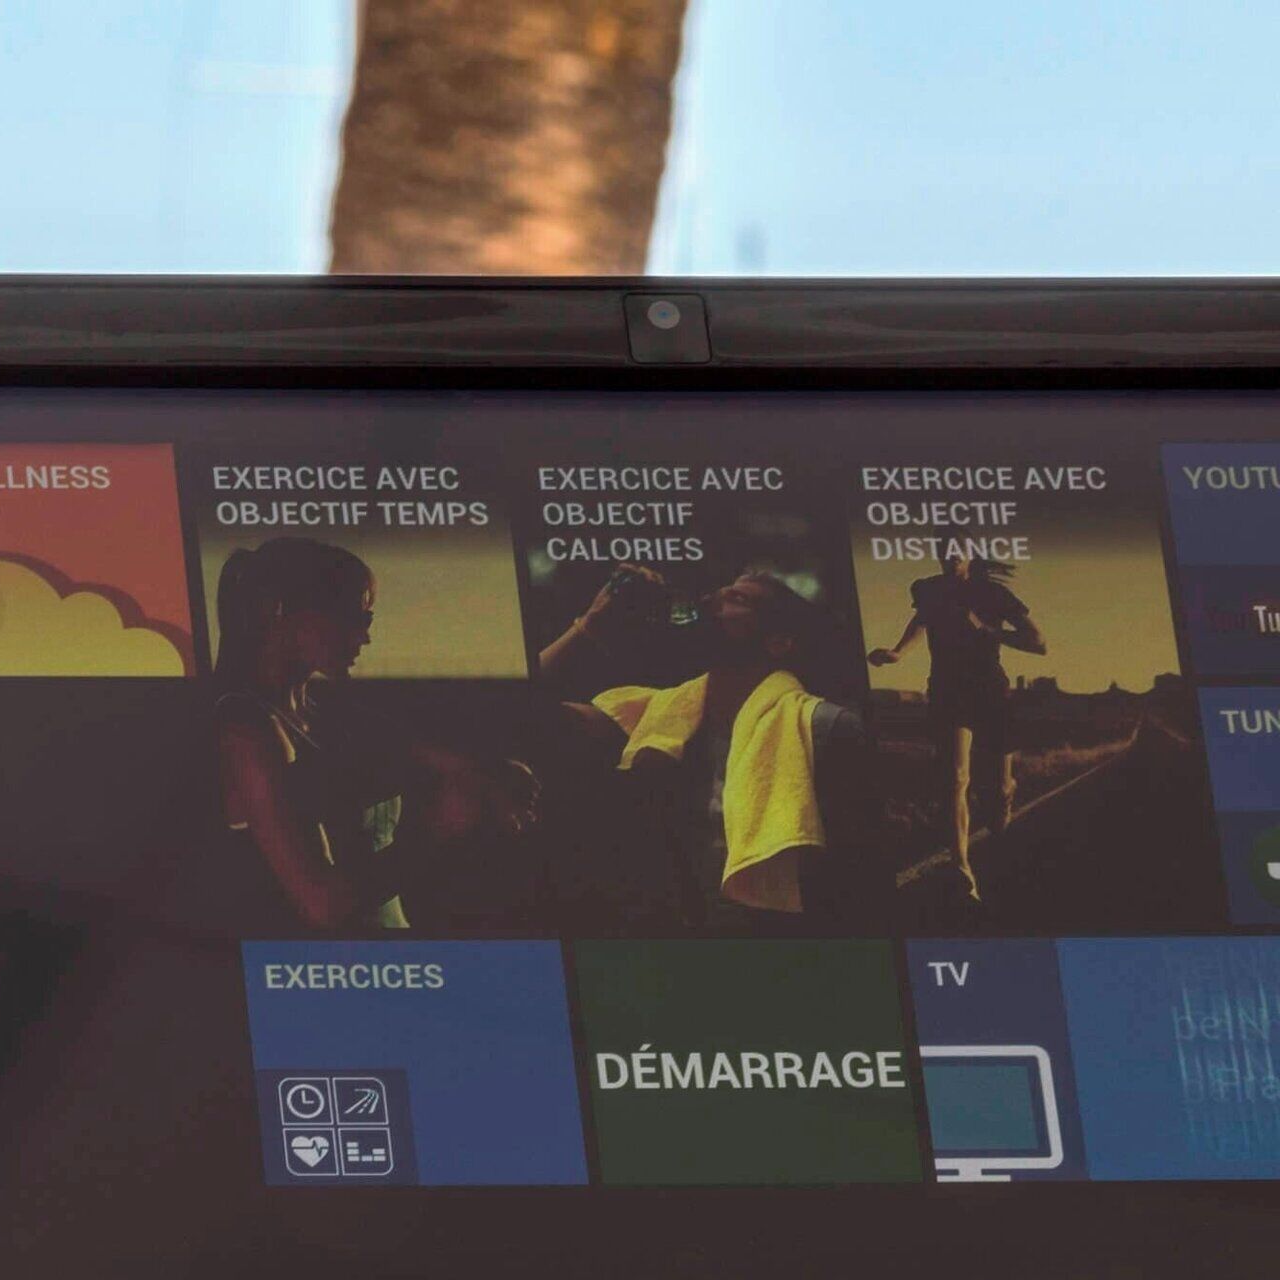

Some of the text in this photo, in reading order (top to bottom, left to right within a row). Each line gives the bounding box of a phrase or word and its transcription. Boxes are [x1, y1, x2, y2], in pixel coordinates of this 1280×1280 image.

[212, 466, 459, 490] EXERCICE AVEC
[538, 467, 783, 491] EXERCICE AVEC
[862, 466, 1106, 490] EXERCICE AVEC
[216, 501, 489, 526] OBJECTIF TEMPS
[542, 502, 693, 526] OBJECTIF
[867, 502, 1017, 526] OBJECTIF
[546, 537, 704, 561] CALORIES
[871, 537, 1031, 561] DISTANCE
[265, 963, 444, 989] EXERCICES
[928, 961, 969, 986] TV
[596, 1043, 906, 1090] DÉMARRAGE
